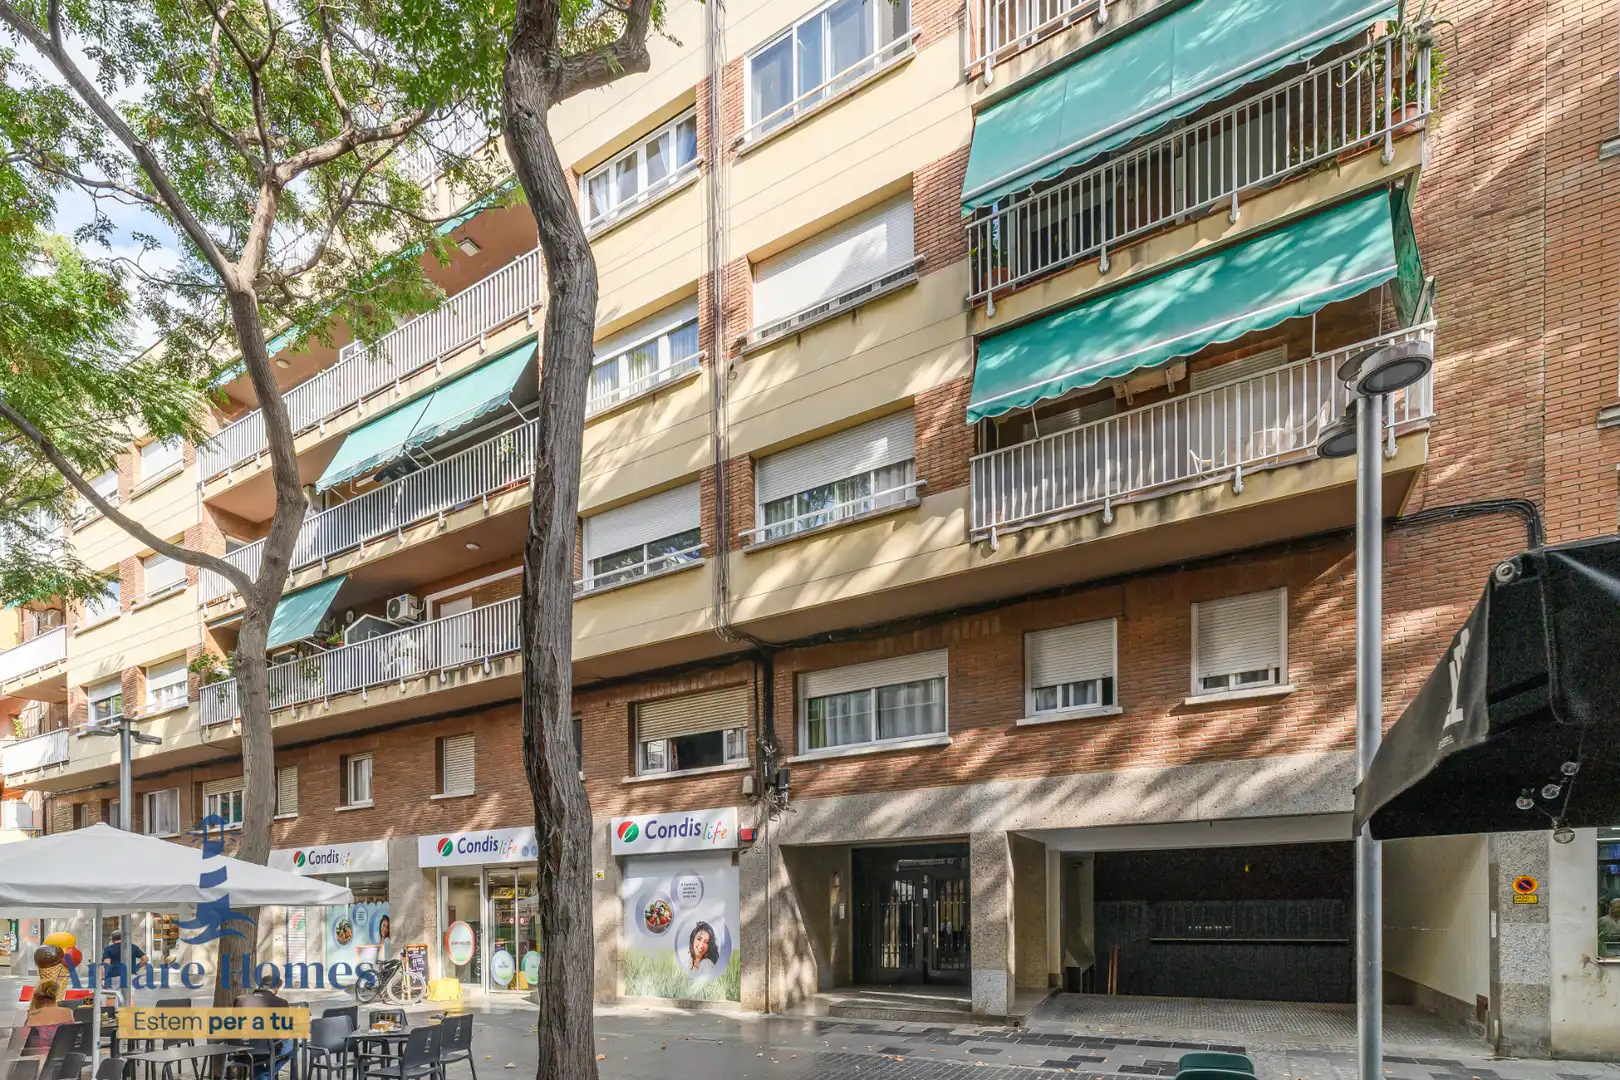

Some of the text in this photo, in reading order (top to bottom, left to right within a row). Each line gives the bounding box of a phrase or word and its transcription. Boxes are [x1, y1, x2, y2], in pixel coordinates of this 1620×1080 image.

[645, 817, 728, 844] Condis life
[308, 849, 339, 865] Condis
[457, 835, 518, 858] Condis life
